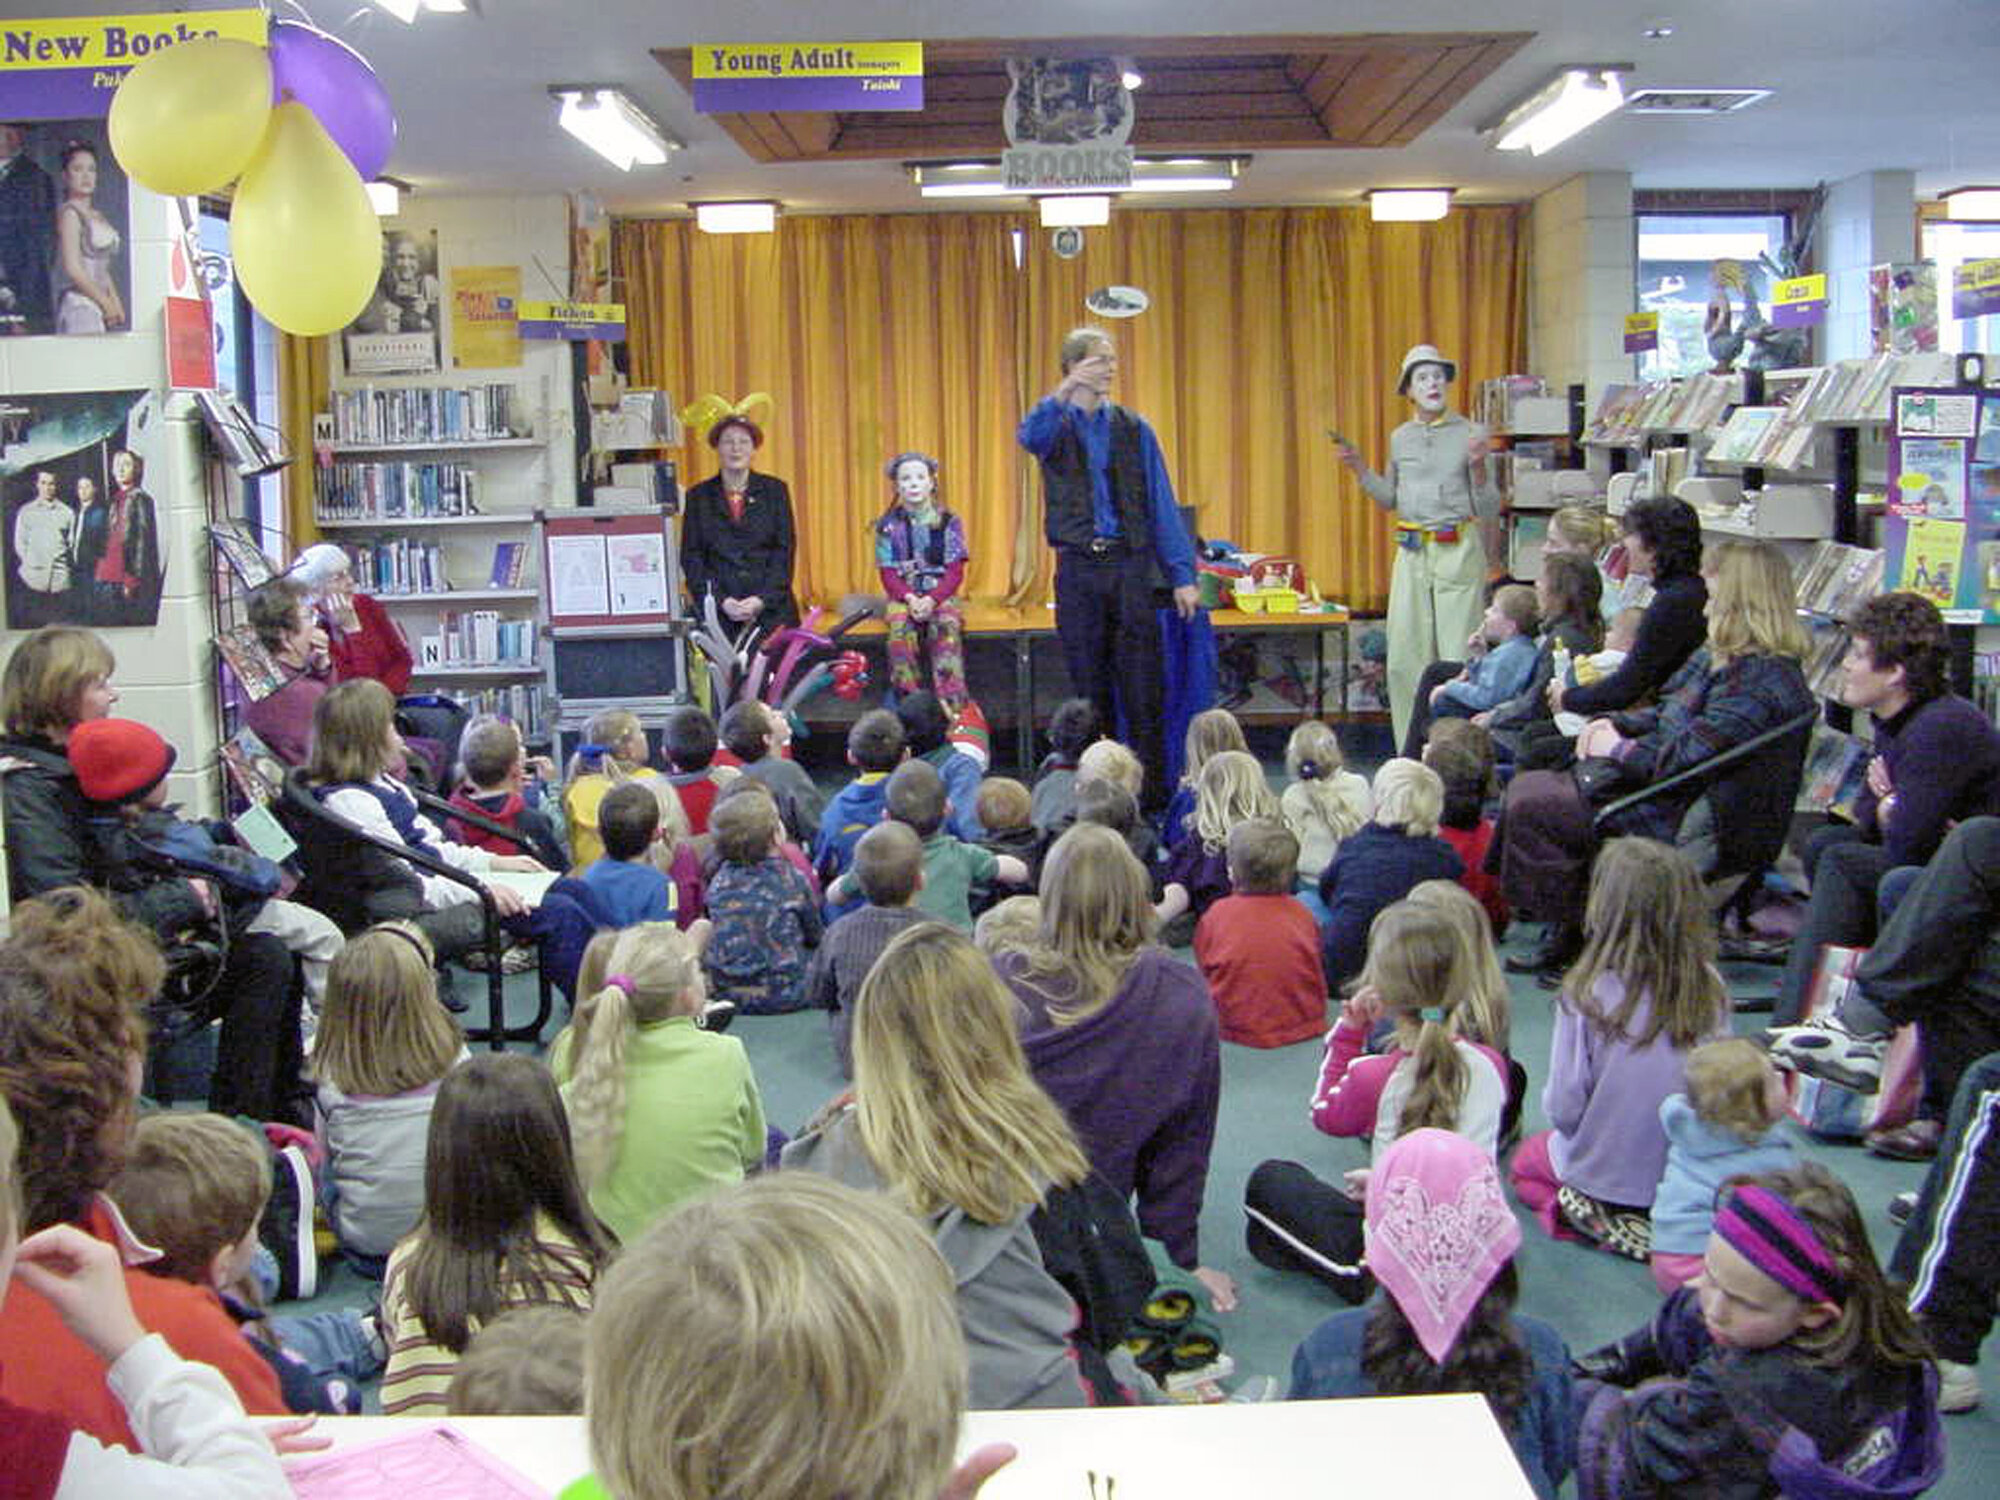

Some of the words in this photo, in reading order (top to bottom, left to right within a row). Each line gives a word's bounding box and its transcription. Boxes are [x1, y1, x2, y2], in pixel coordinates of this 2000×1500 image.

[4, 31, 90, 62] New
[711, 49, 781, 75] Young
[790, 47, 854, 70] Adult
[1006, 150, 1130, 175] BOOKS
[317, 421, 331, 440] M
[426, 644, 438, 662] N
